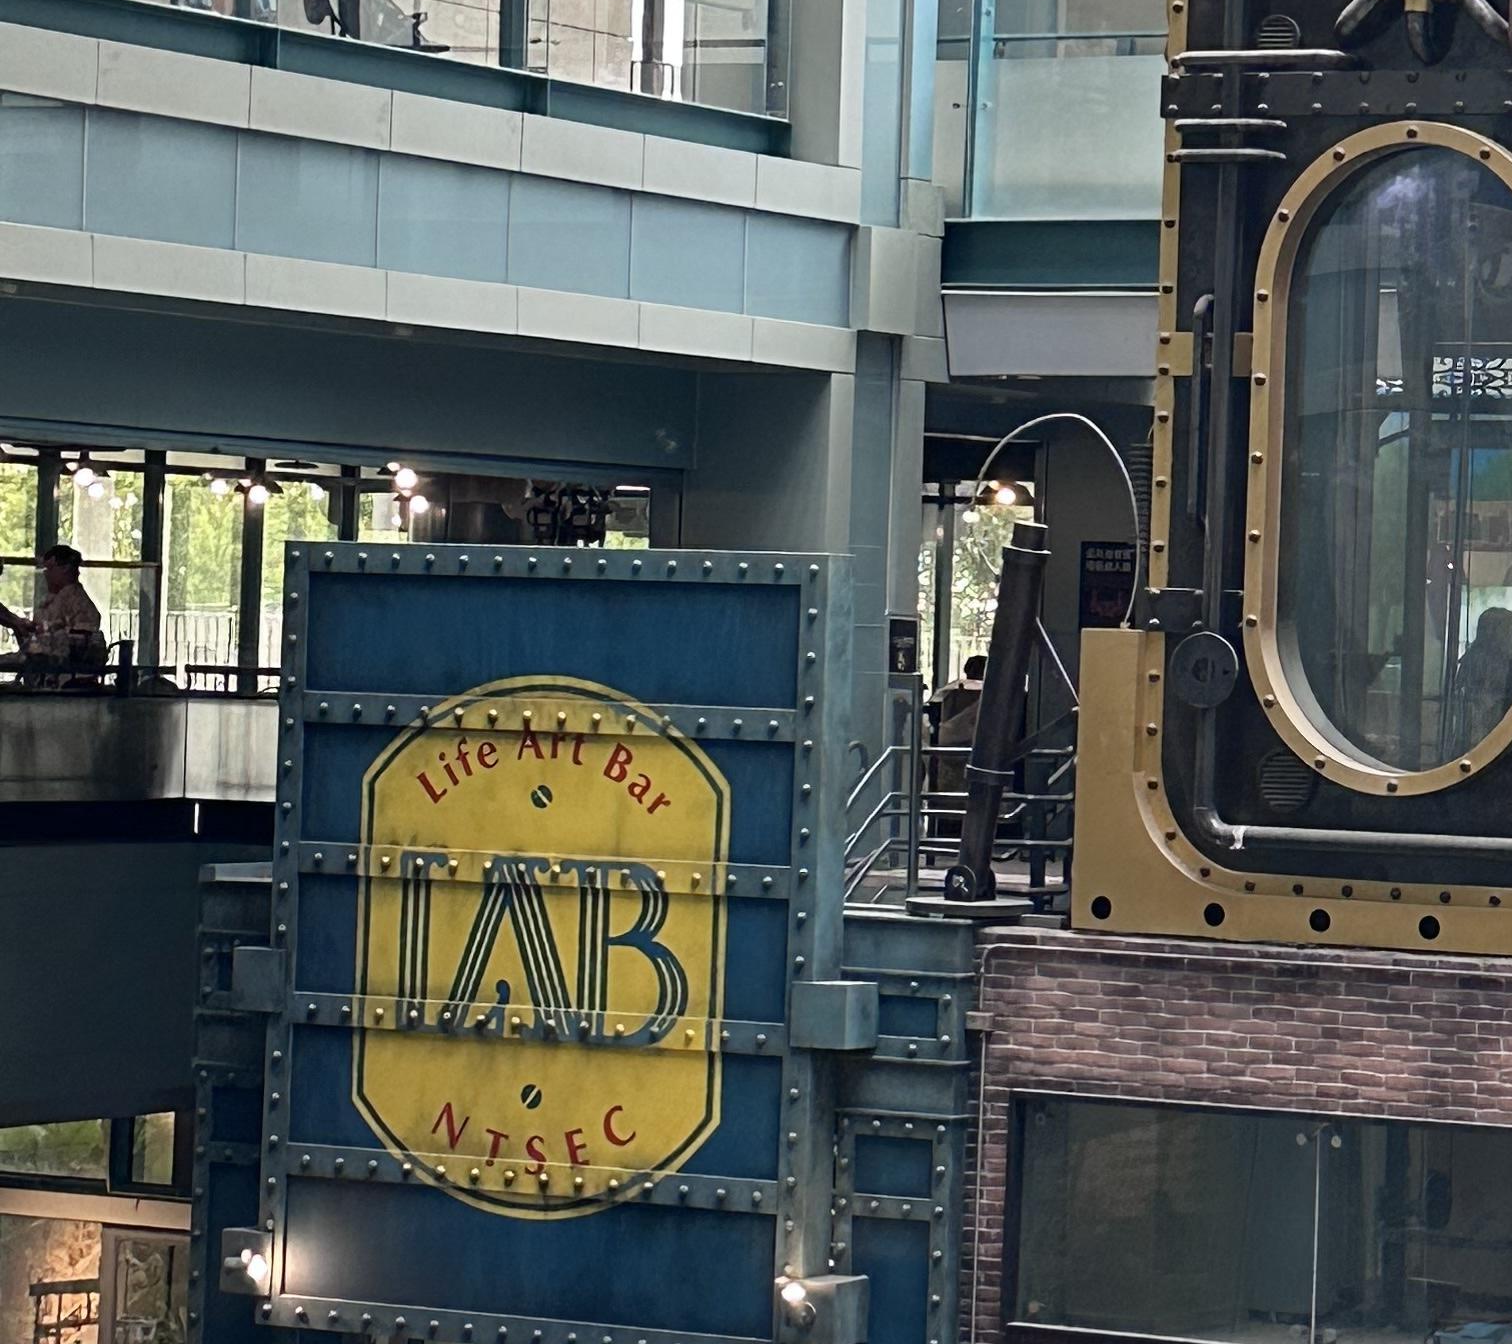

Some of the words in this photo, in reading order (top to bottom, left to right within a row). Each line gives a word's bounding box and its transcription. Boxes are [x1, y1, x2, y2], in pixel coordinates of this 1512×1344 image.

[416, 736, 500, 805] Life
[516, 726, 585, 766] Art
[603, 742, 671, 816] Bar
[431, 1101, 637, 1176] NTSEC
